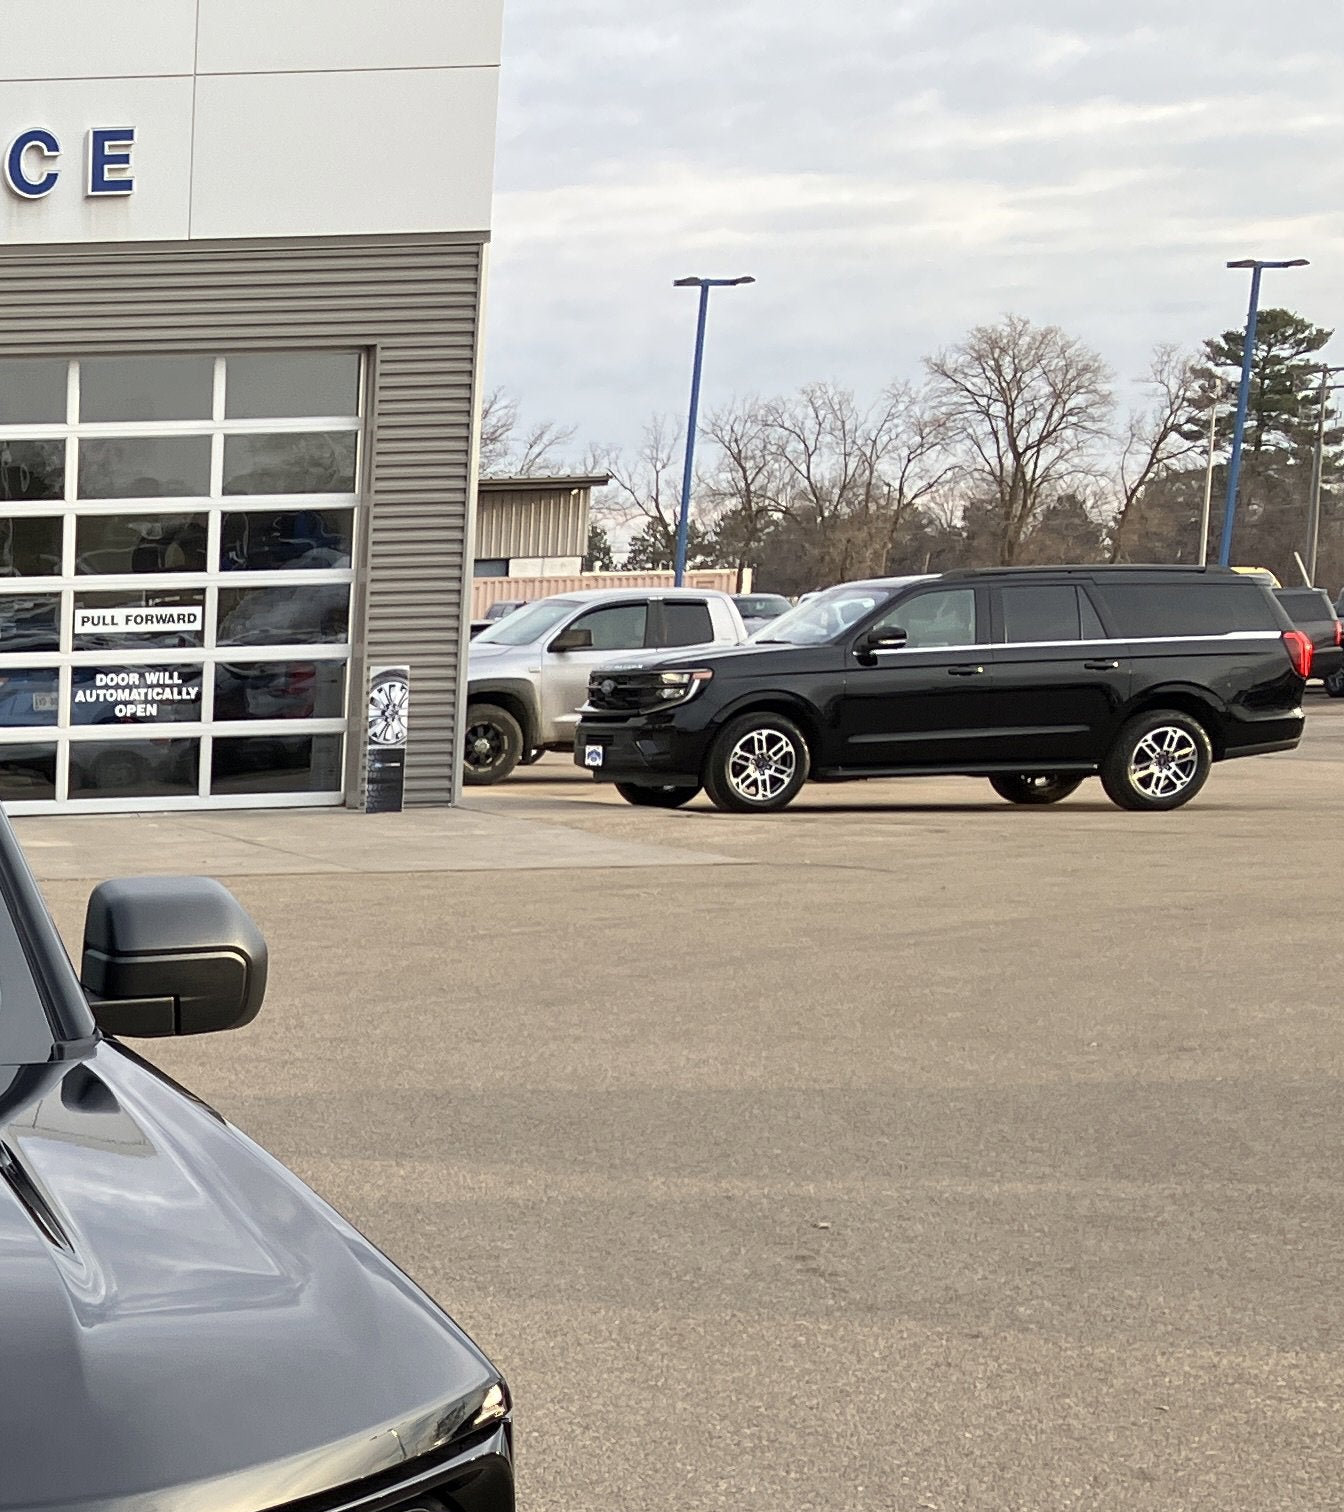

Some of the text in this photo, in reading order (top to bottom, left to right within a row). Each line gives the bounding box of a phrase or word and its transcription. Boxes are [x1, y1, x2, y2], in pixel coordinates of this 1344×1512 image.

[80, 612, 198, 627] PULL FORWARD
[95, 671, 183, 687] DOOR WILL
[75, 687, 199, 703] AUTOMATICALLY
[114, 703, 158, 718] OPEN
